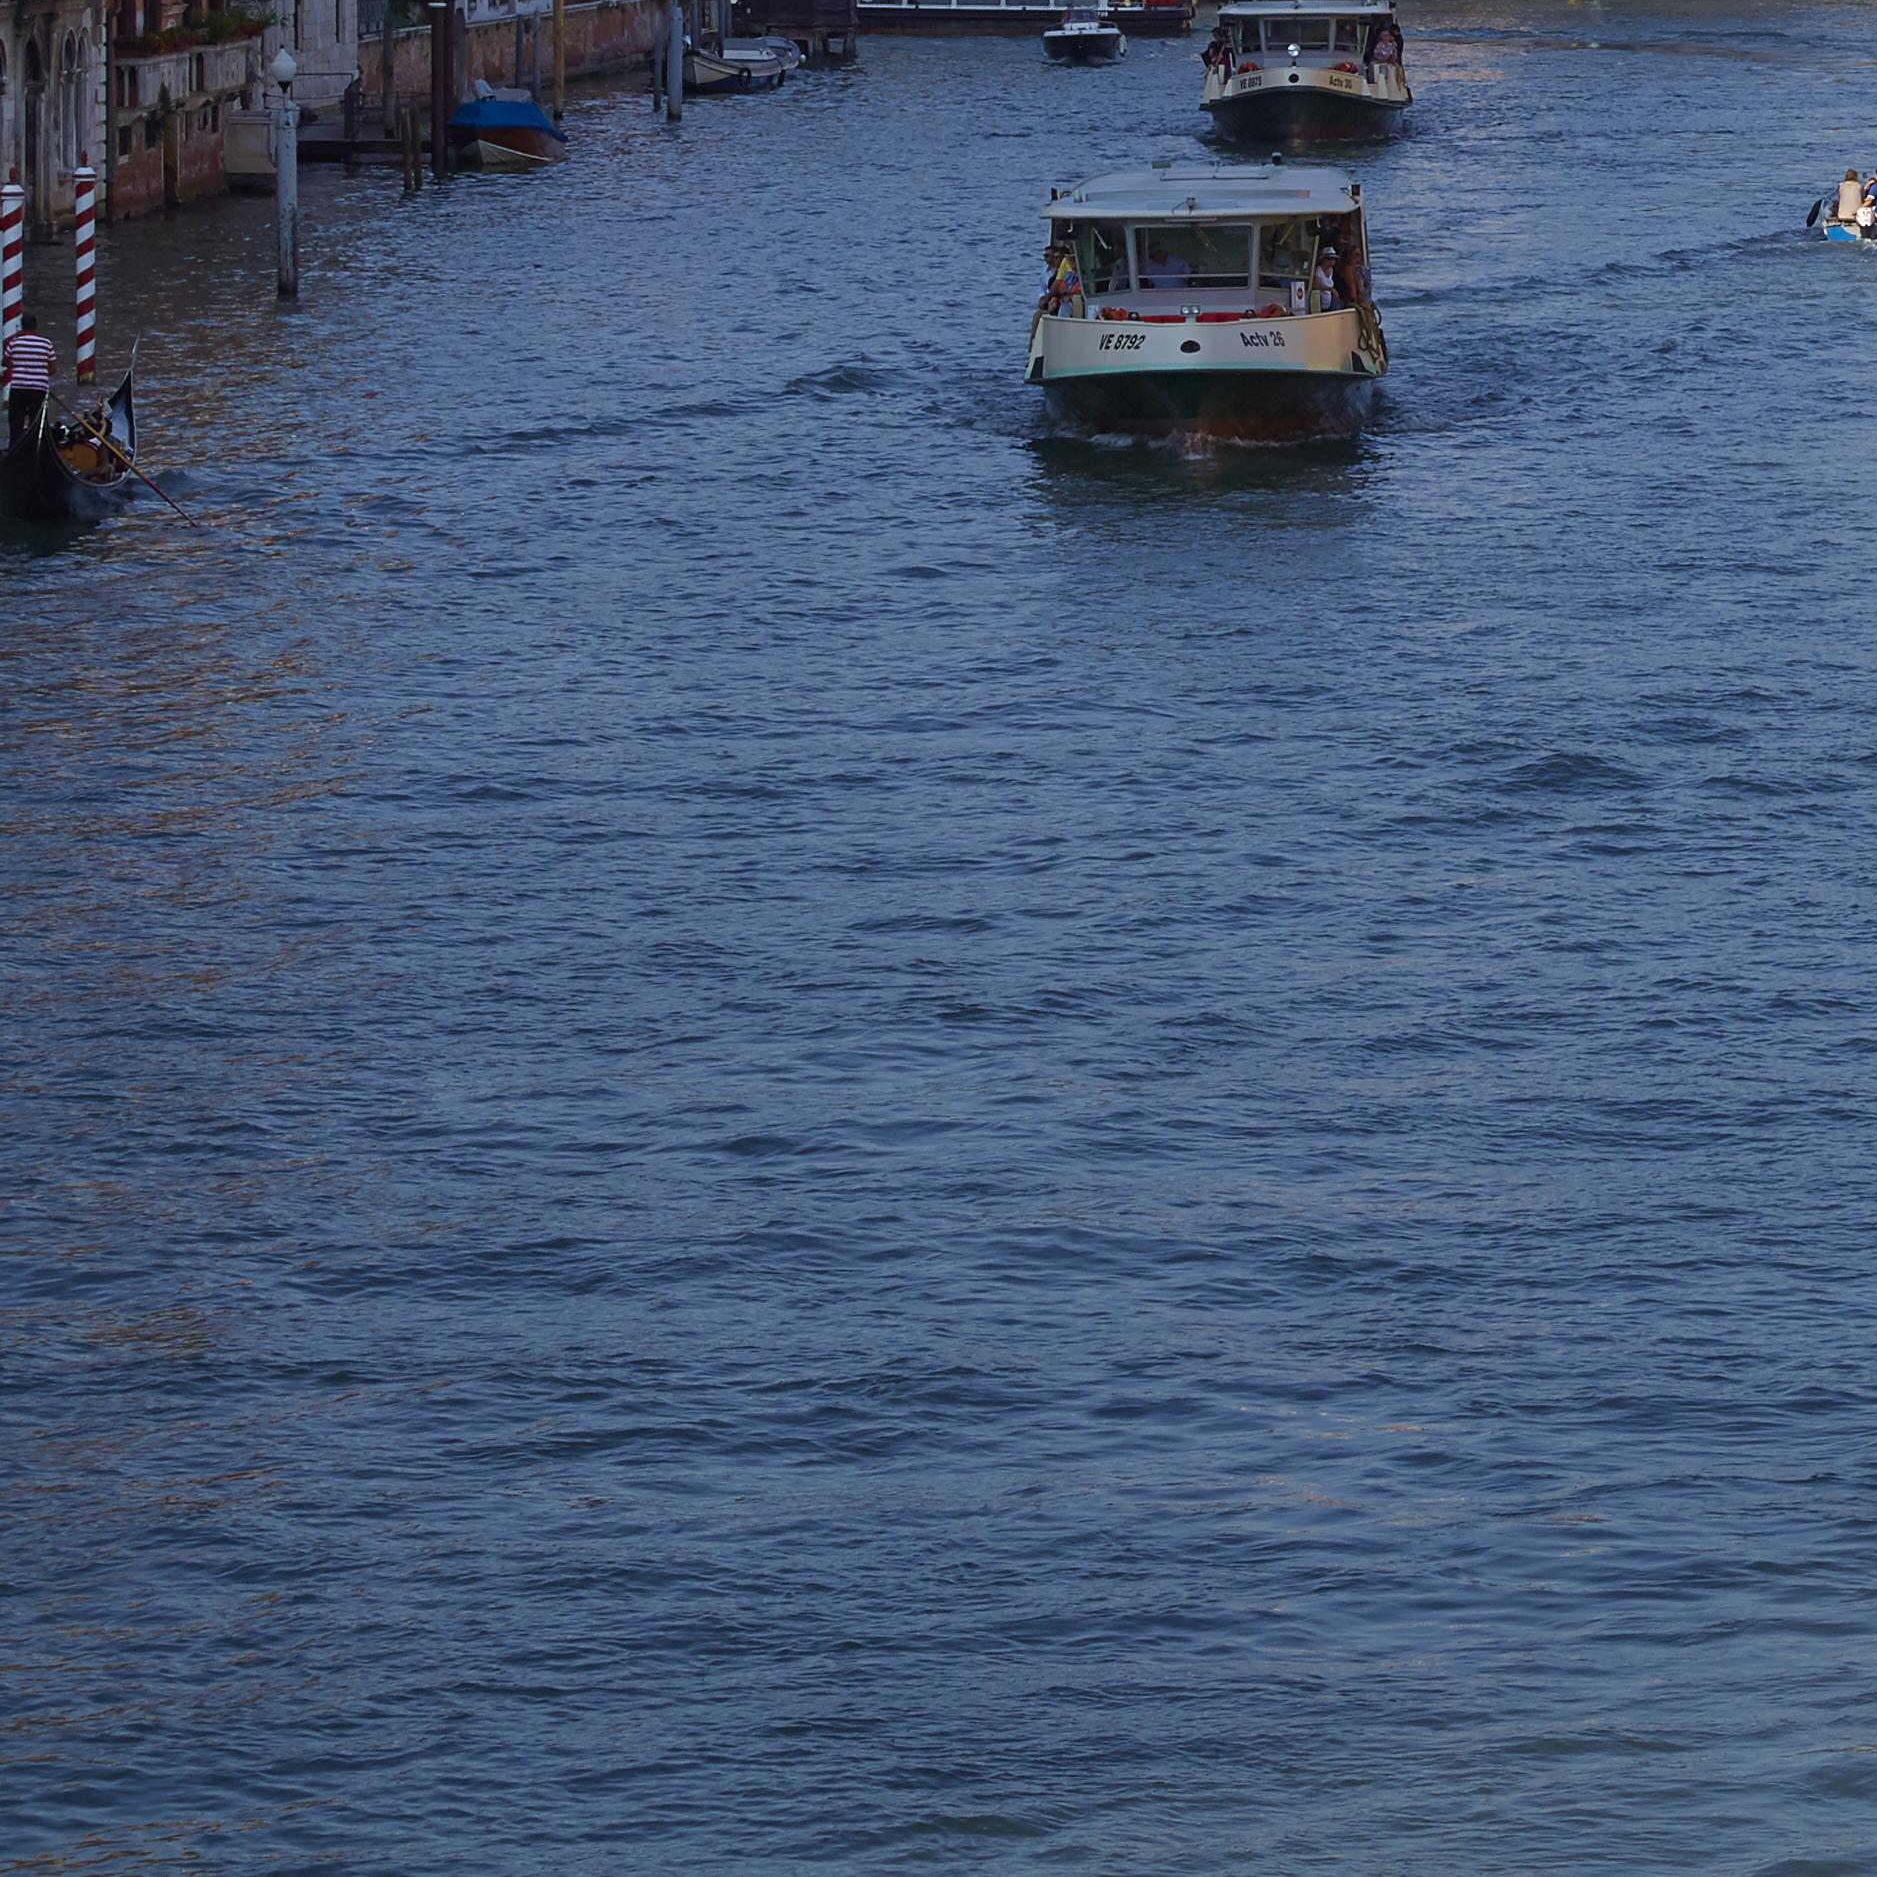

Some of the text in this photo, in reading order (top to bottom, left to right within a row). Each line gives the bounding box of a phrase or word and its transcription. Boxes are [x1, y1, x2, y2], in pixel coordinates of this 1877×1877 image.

[1099, 334, 1147, 350] VE 8792
[1240, 331, 1286, 348] Actv 26
